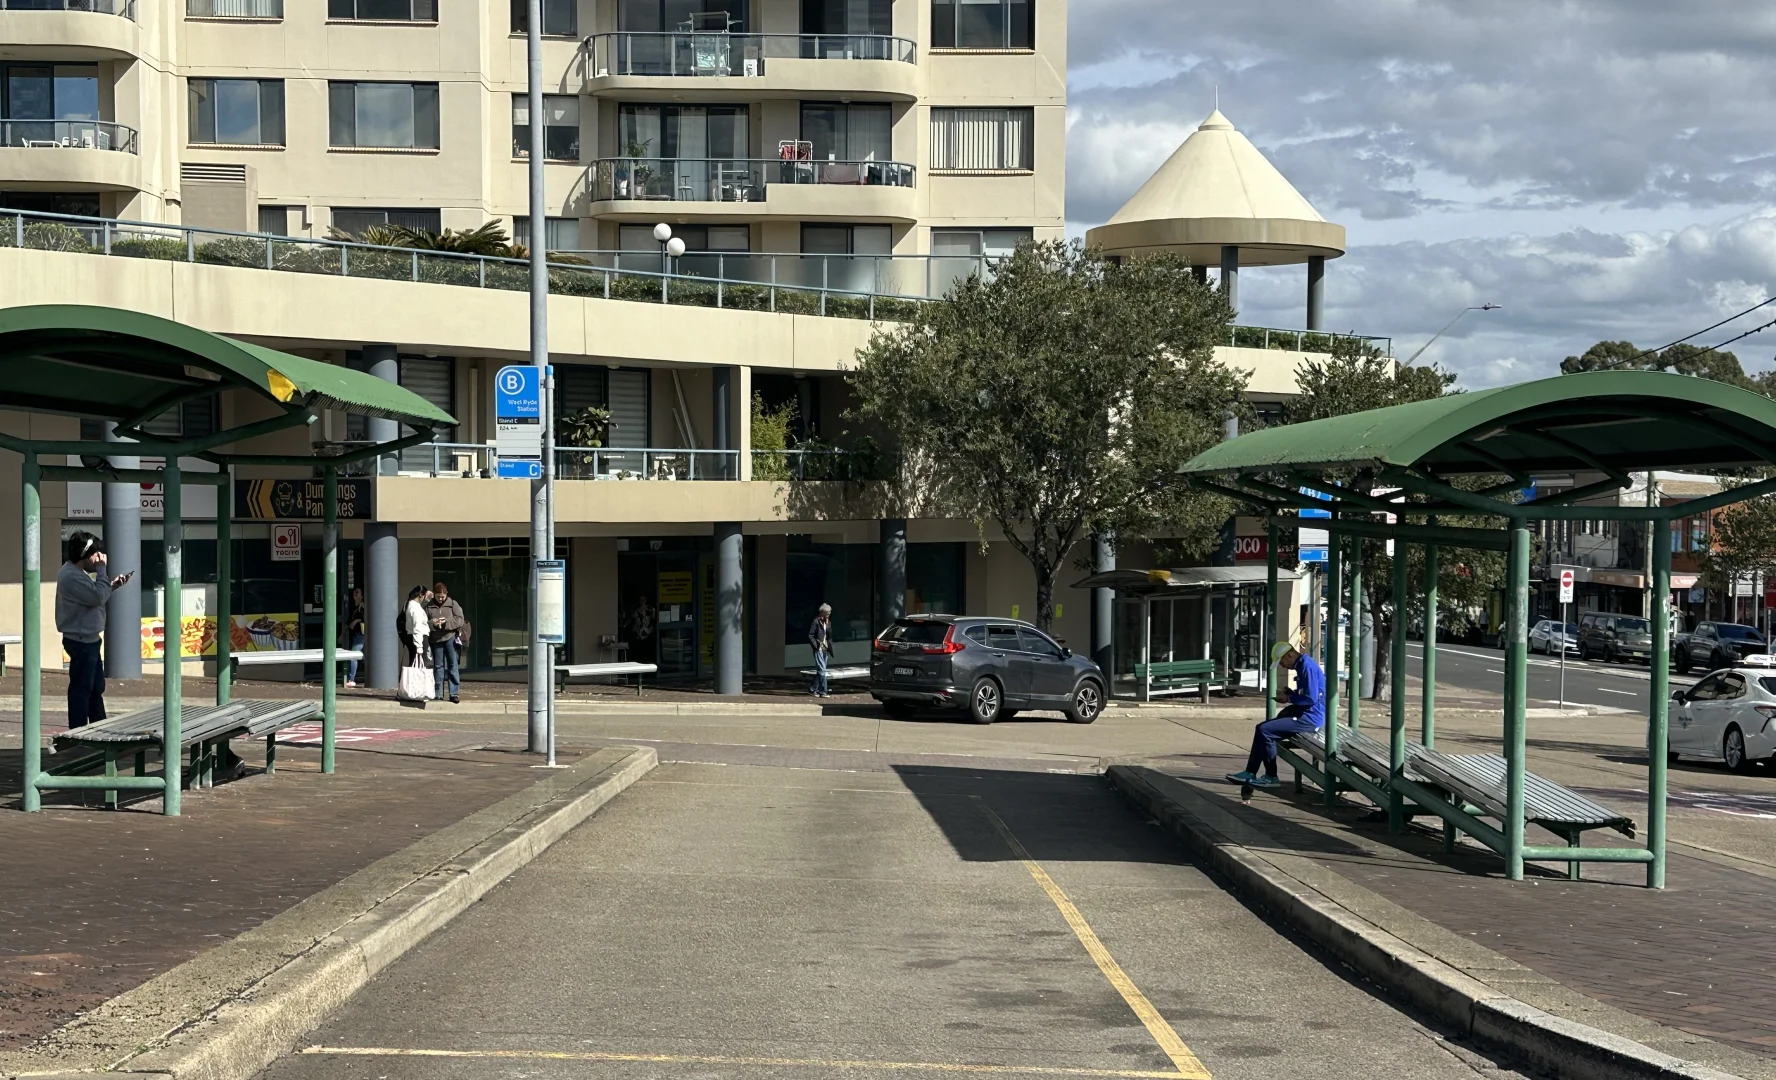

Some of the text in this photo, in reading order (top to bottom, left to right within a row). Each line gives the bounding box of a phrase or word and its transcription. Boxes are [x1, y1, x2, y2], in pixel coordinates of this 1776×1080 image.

[507, 375, 518, 389] B
[529, 463, 538, 476] C
[296, 491, 304, 509] &
[305, 482, 356, 500] Dumngs
[305, 499, 354, 517] Pankes
